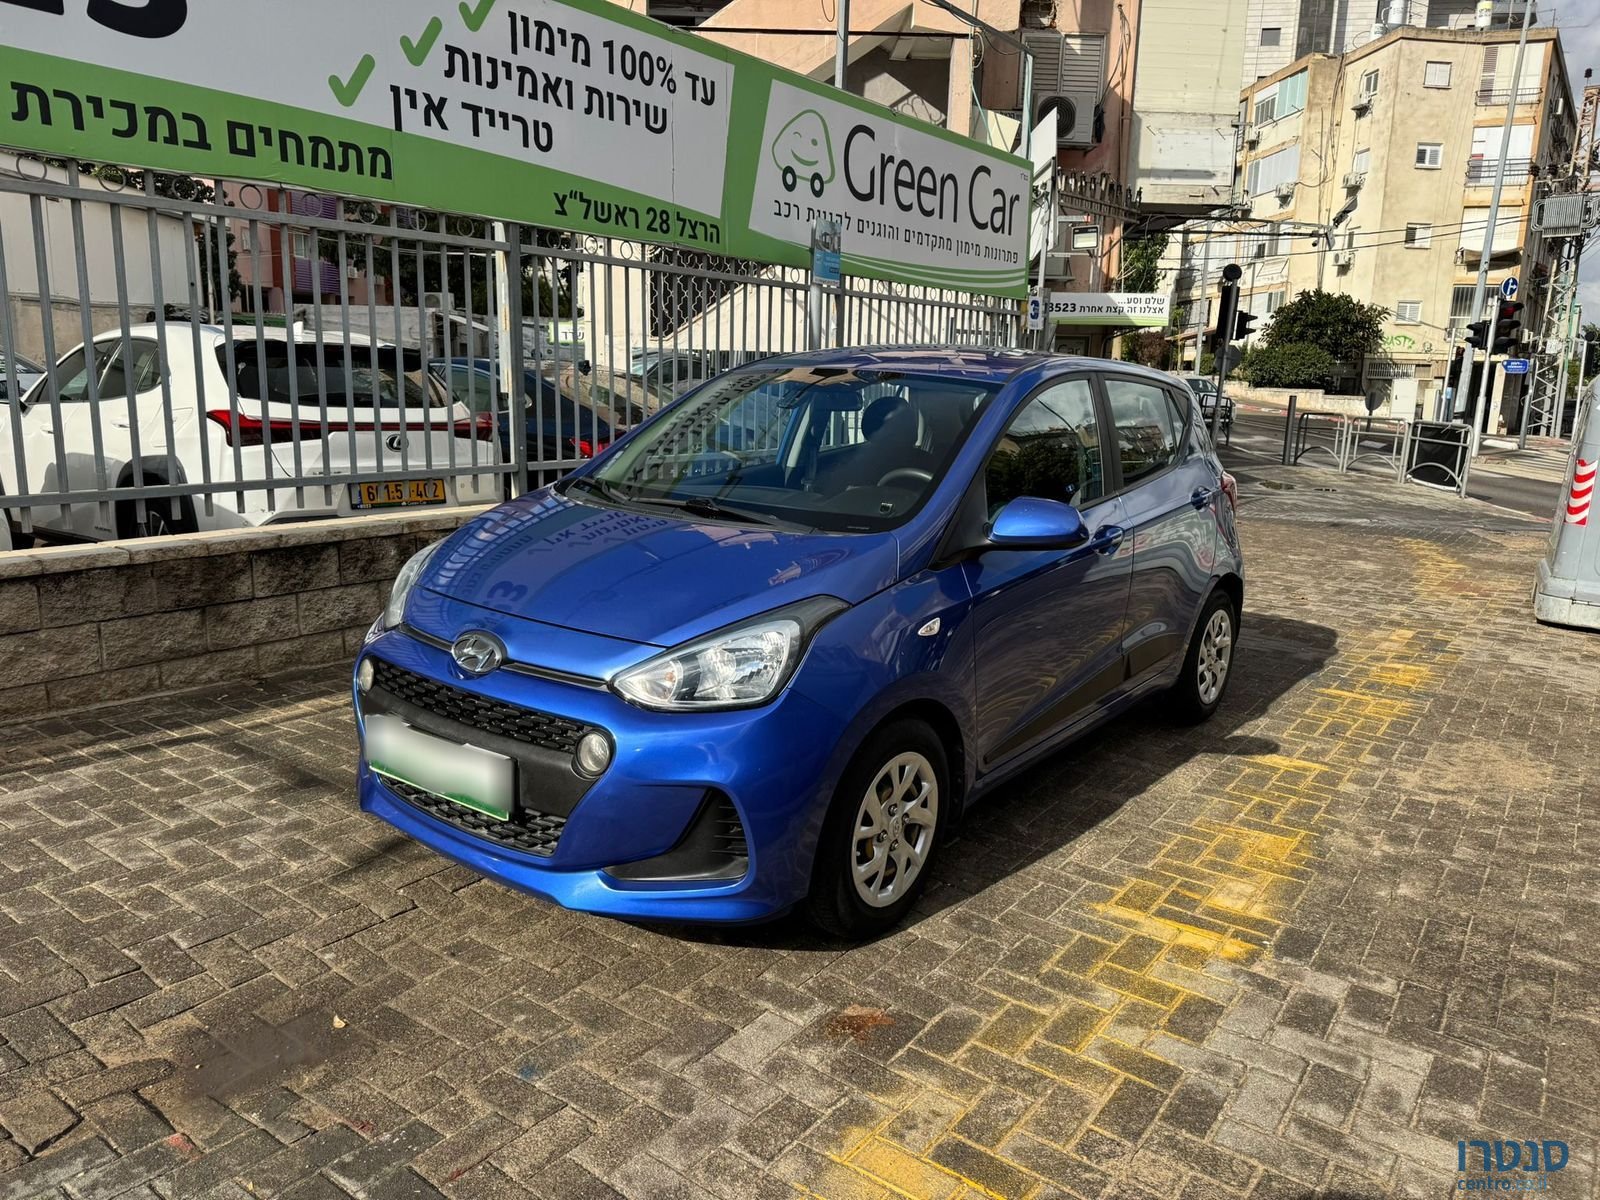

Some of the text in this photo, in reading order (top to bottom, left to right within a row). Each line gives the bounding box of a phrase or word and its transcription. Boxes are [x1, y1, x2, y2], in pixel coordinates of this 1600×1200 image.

[507, 10, 716, 106] עד 100% מימון
[444, 43, 668, 134] שירות ואמינות
[390, 84, 553, 153] טרייד אין
[10, 80, 393, 181] מתמחים במכירת
[843, 124, 1020, 236] Green Car
[645, 206, 671, 235] 28
[773, 199, 800, 221] רכב
[676, 211, 721, 245] הרצל
[857, 218, 899, 241] והוגנים
[904, 229, 953, 252] מתקדמים
[956, 240, 981, 256] מימון
[983, 245, 1018, 264] פתרונות
[1079, 305, 1104, 314] אחרת
[1105, 305, 1125, 316] קצת
[1126, 306, 1137, 314] זה
[1139, 305, 1164, 314] אצלנו
[1144, 296, 1165, 306] שלם
